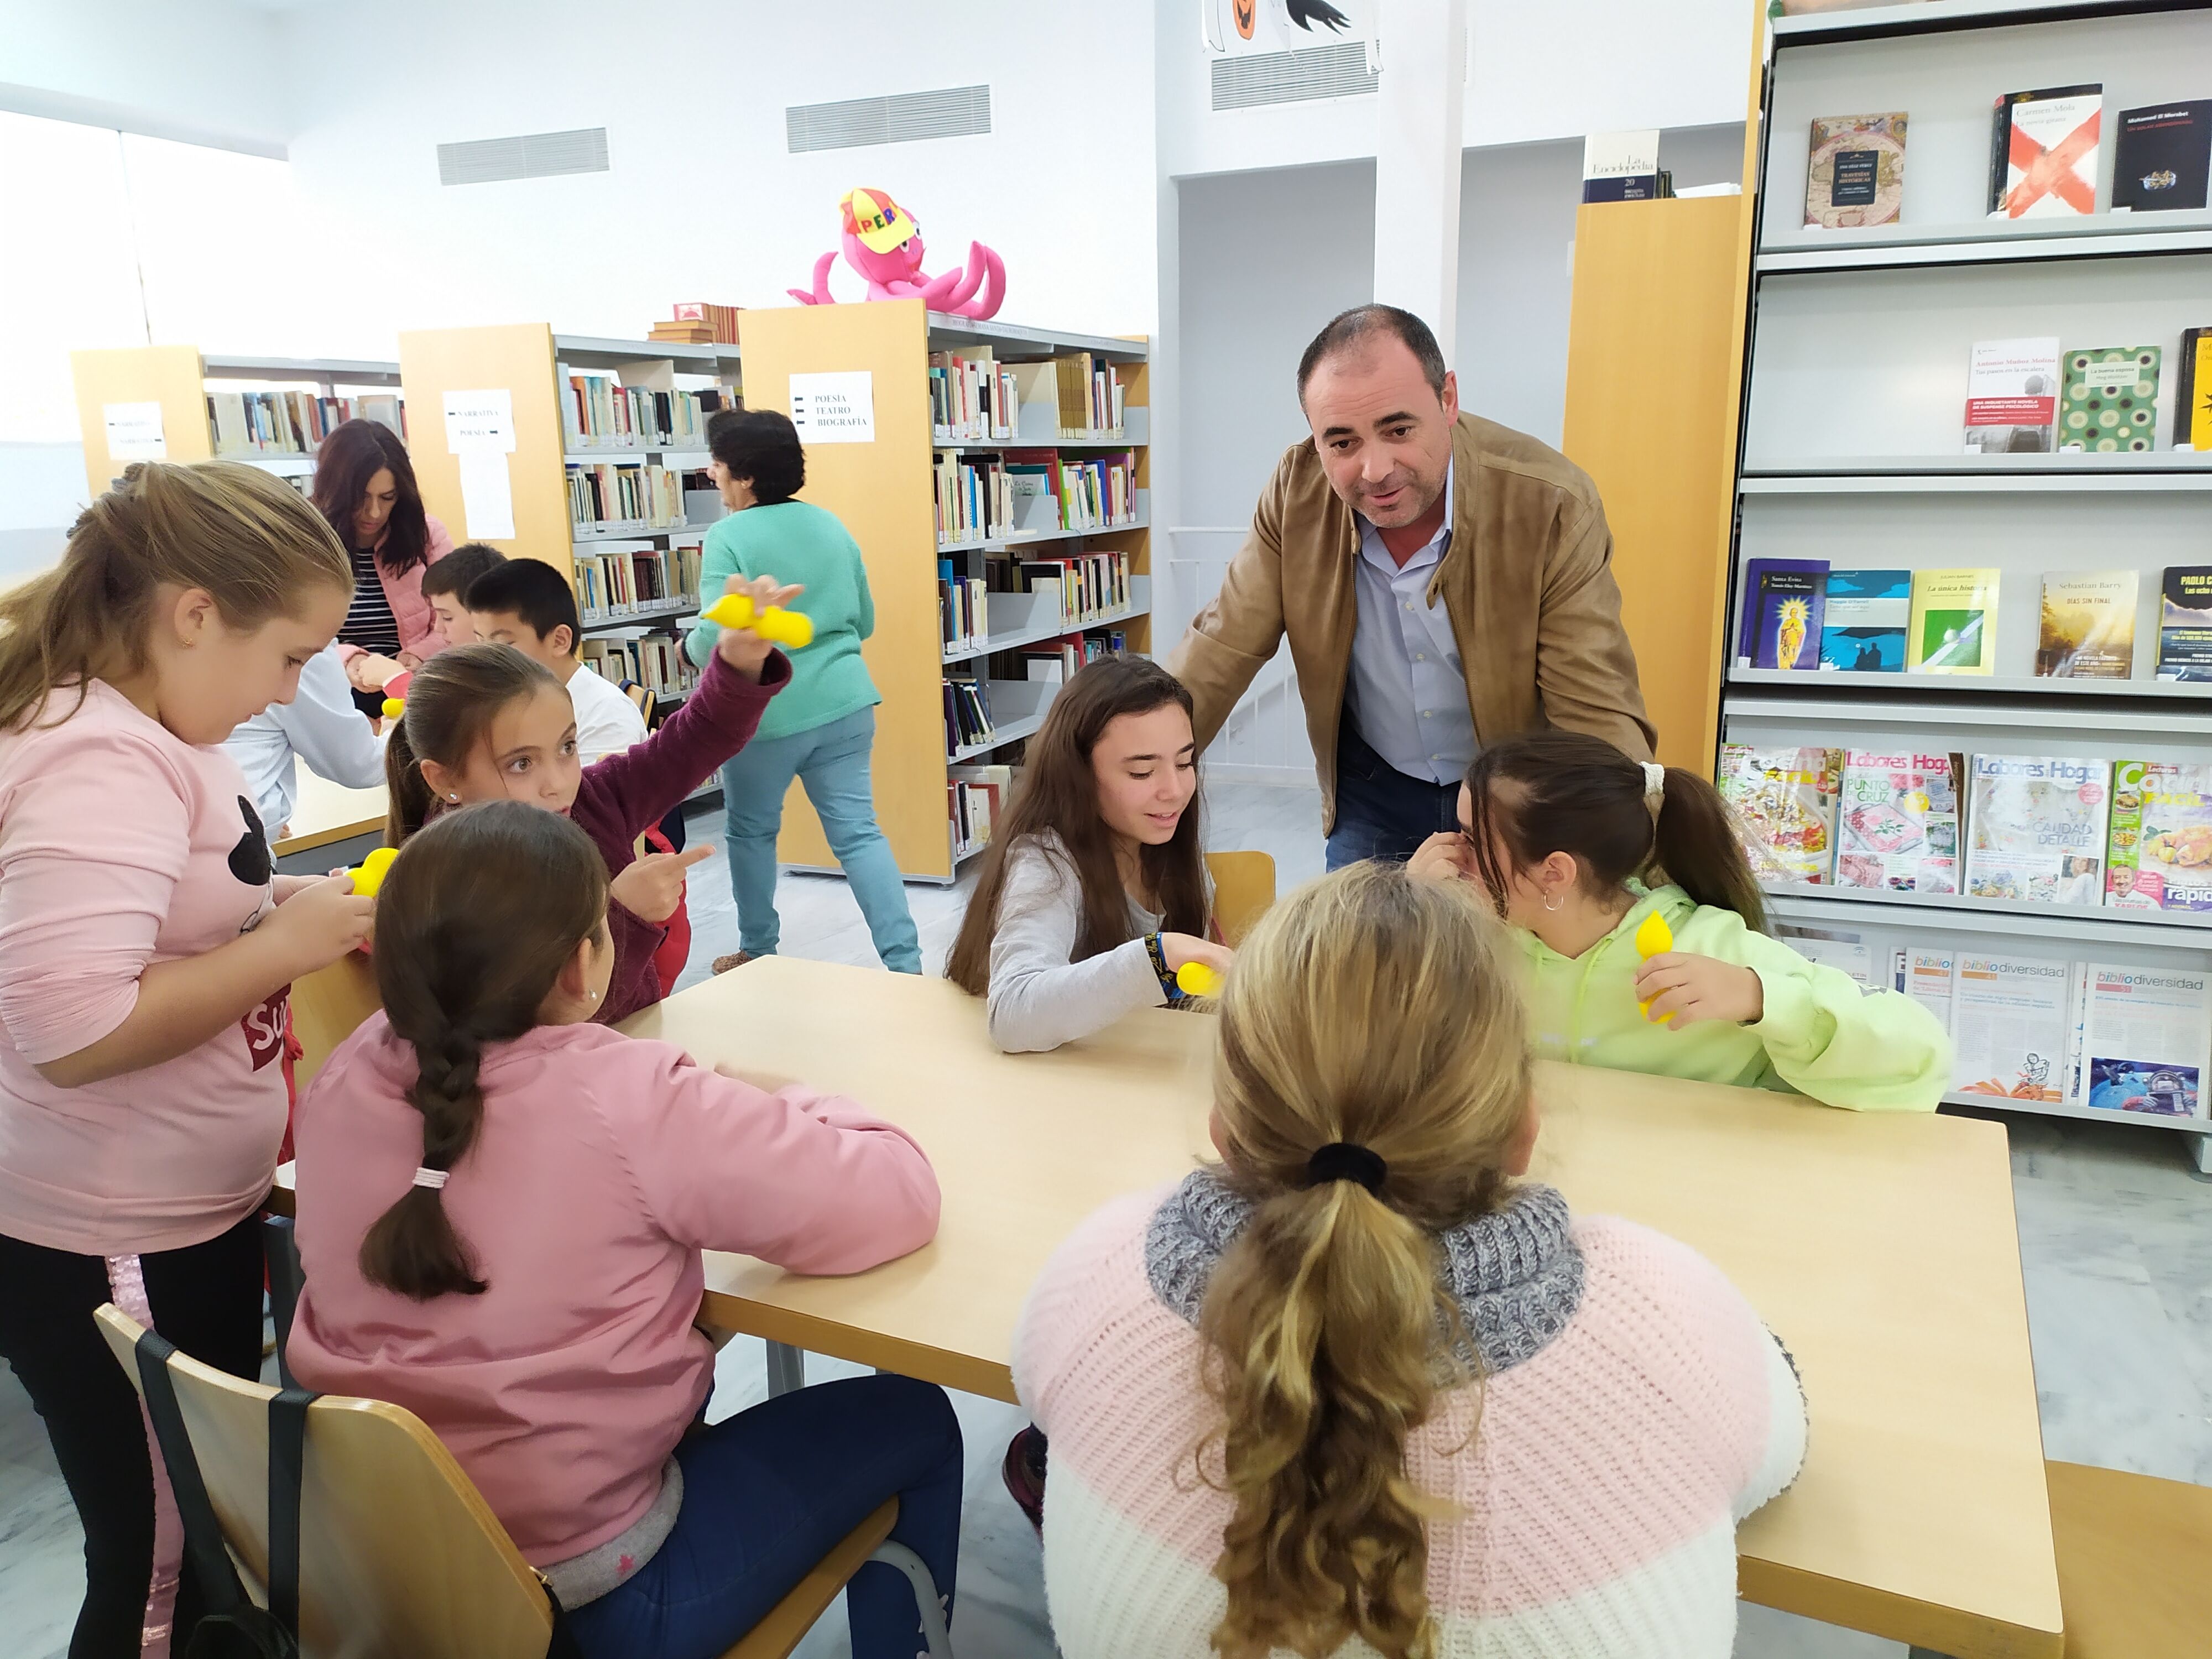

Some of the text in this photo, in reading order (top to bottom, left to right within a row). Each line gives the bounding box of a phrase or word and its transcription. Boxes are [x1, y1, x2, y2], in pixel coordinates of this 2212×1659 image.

[2016, 104, 2075, 117] Carmen Mola
[1624, 178, 1635, 187] 20
[815, 394, 847, 403] POESÍA
[816, 406, 851, 415] TEATRO
[818, 416, 867, 426] BIOGRAFÍA
[2181, 576, 2212, 586] PAOLO C
[1846, 751, 1907, 769] Labores
[1978, 758, 2044, 778] Labores
[2050, 761, 2104, 785] Hogar
[2147, 765, 2177, 774] Lecturas
[2118, 763, 2212, 793] Cocin
[1847, 779, 1890, 791] PUNTO
[1857, 791, 1889, 802] CRUZ
[2032, 822, 2093, 835] CALIDAD
[2038, 833, 2091, 847] DETALLE
[1963, 959, 2064, 978] bibliodiversidad
[2096, 971, 2204, 990] bibliodiversidad
